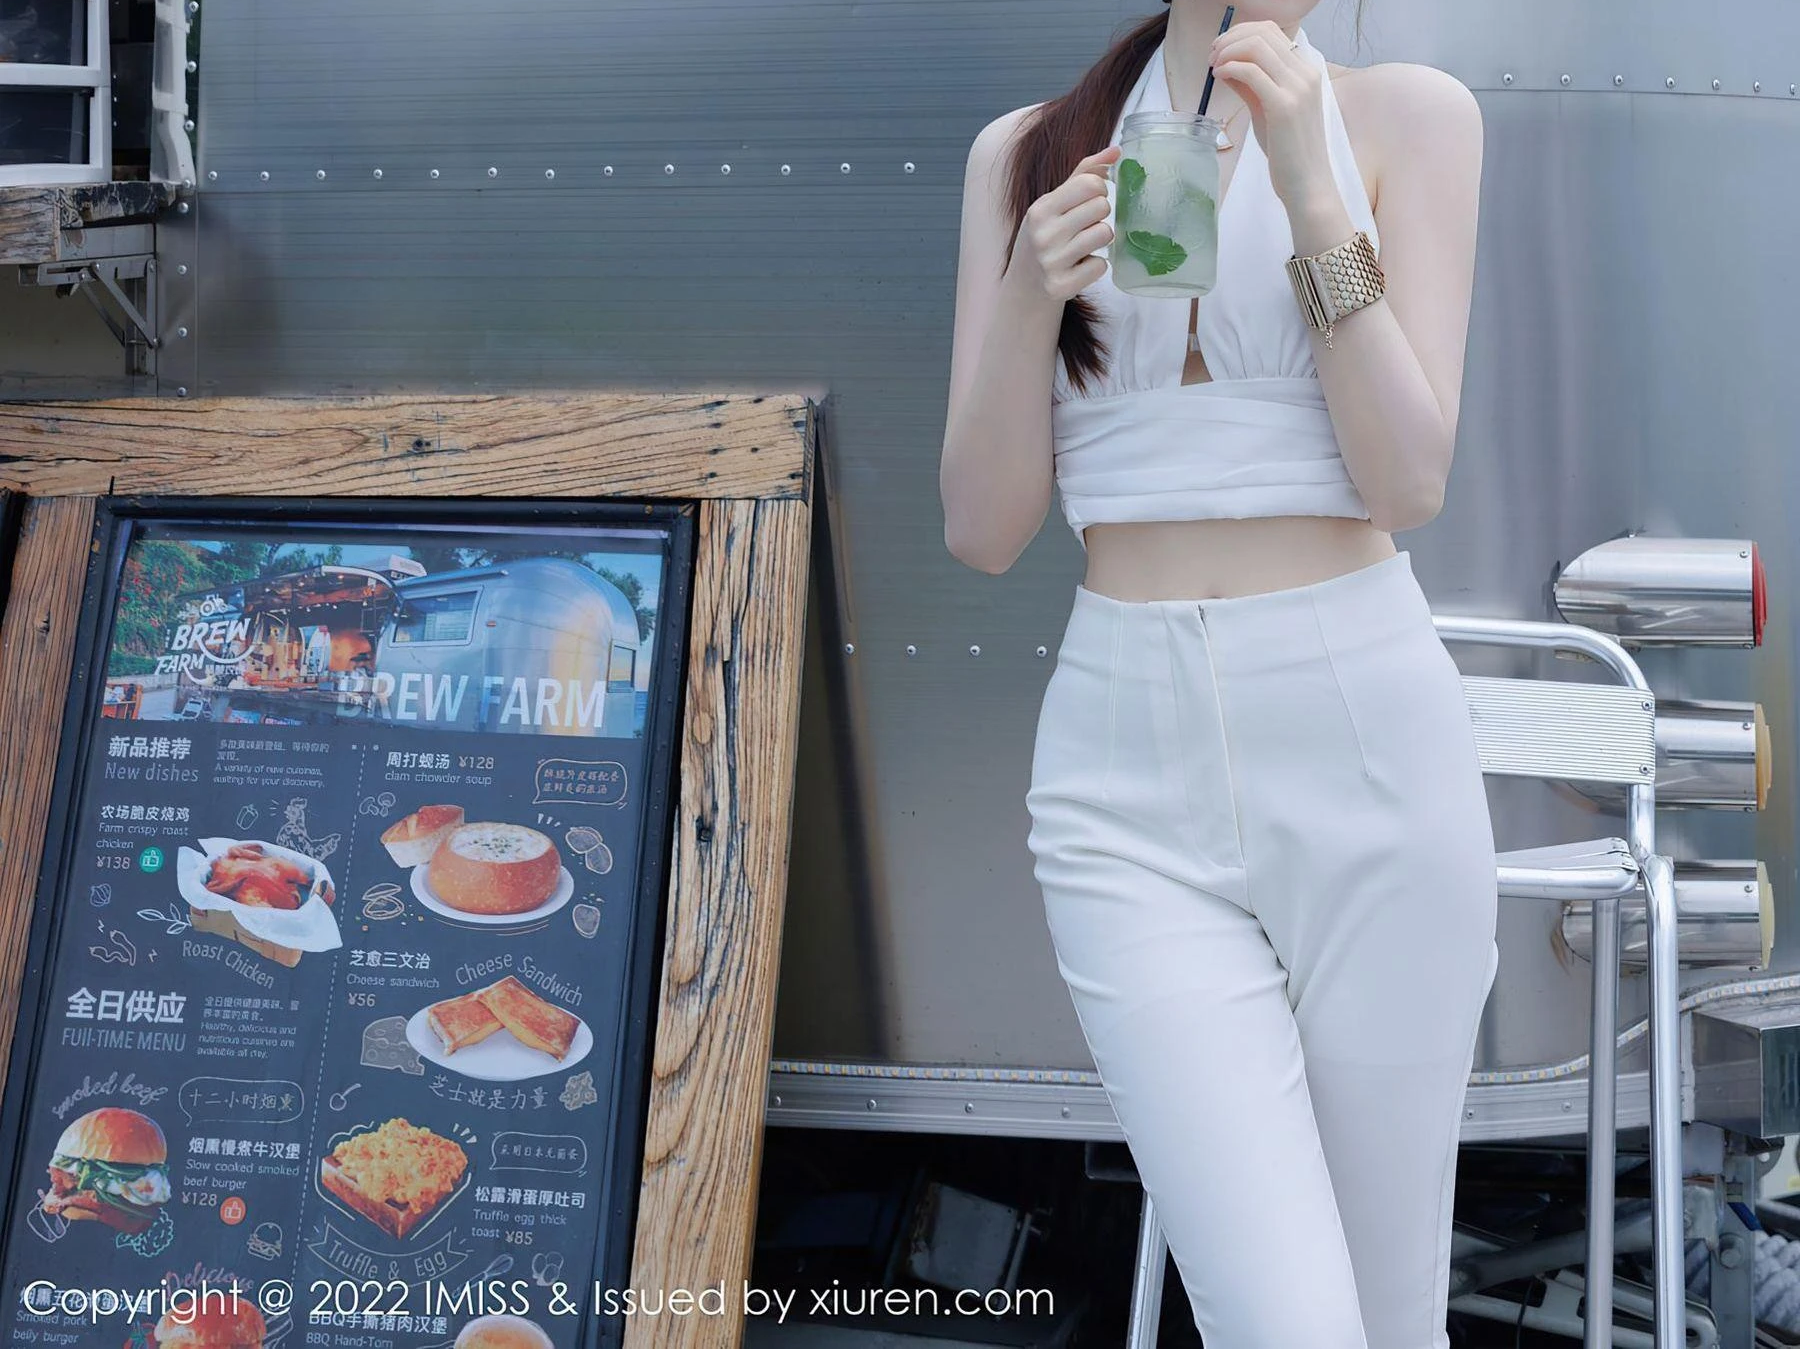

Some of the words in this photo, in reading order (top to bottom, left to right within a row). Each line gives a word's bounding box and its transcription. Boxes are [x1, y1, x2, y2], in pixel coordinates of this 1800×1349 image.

[170, 618, 255, 660] BREW
[154, 653, 207, 679] FARM
[336, 671, 468, 722] BREW
[481, 675, 606, 728] FARM
[108, 736, 192, 760] 新品推荐
[459, 755, 495, 769] ¥128
[104, 762, 140, 780] New
[146, 762, 199, 782] dishes
[385, 771, 410, 781] clam
[415, 773, 461, 783] chowder
[466, 775, 492, 786] soup
[101, 805, 190, 822] 农场脆皮烧鸡
[98, 823, 124, 833] Farm
[128, 825, 158, 837] crispy
[162, 826, 189, 836] roast
[96, 839, 133, 849] chicken
[96, 856, 131, 870] ¥138
[182, 940, 224, 962] Roast
[225, 950, 274, 990] Chicken
[346, 973, 385, 986] Cheese
[390, 976, 440, 989] sandwich
[455, 953, 513, 986] Cheese
[517, 955, 583, 1007] Sandwich
[65, 986, 187, 1025] 全日供应
[348, 992, 376, 1007] ¥56
[137, 1032, 186, 1052] MENU
[428, 1074, 549, 1110] 芝士就是力量
[189, 1137, 300, 1159] 烟熏慢煮牛汉堡
[186, 1159, 211, 1170] Slow
[215, 1162, 253, 1173] cooked
[259, 1165, 299, 1176] smoked
[183, 1175, 208, 1186] beef
[212, 1178, 247, 1191] burger
[182, 1191, 217, 1206] ¥128
[475, 1186, 585, 1208] 松露滑蛋厚吐司
[473, 1209, 509, 1222] Truffle
[514, 1214, 535, 1226] egg
[540, 1213, 567, 1225] thick
[472, 1227, 500, 1238] toast
[505, 1230, 533, 1245] ¥85
[327, 1240, 378, 1280] Truffle
[388, 1260, 400, 1281] &
[414, 1250, 447, 1277] Egg
[16, 1310, 59, 1324] Smoked
[63, 1315, 88, 1327] pork
[13, 1329, 39, 1342] belly
[43, 1331, 79, 1345] burger
[306, 1332, 330, 1347] BBQ
